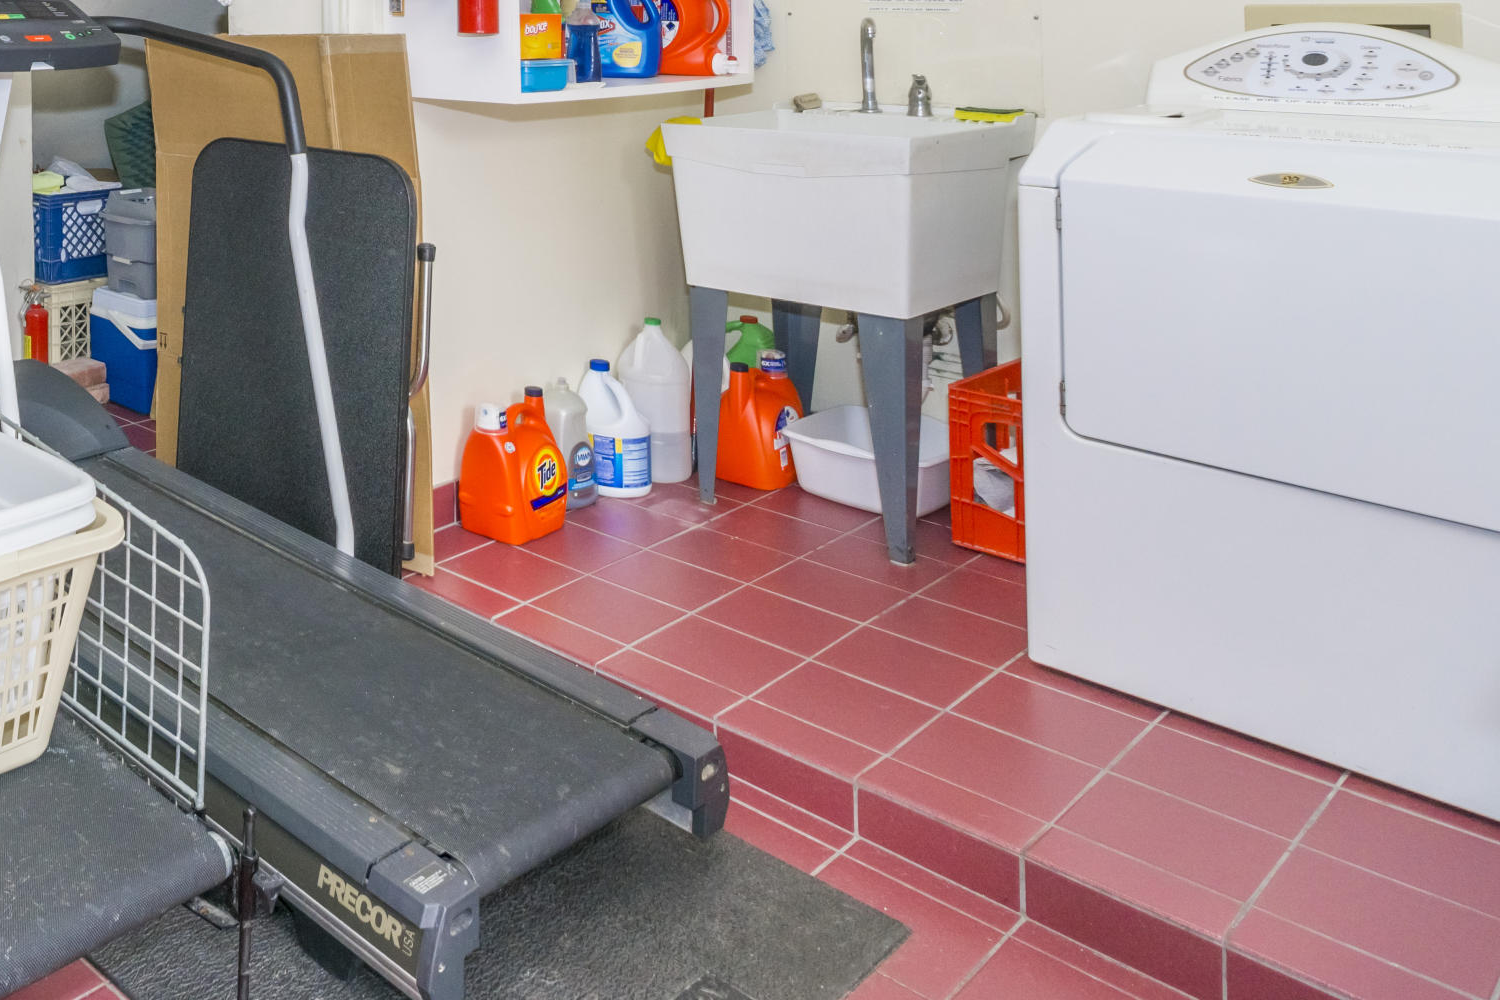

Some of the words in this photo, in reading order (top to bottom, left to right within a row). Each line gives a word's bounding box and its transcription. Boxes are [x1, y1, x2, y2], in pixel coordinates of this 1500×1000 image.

[525, 22, 548, 35] bounce
[537, 459, 556, 491] Tide
[317, 863, 402, 949] PRECOR
[402, 929, 416, 957] USA
